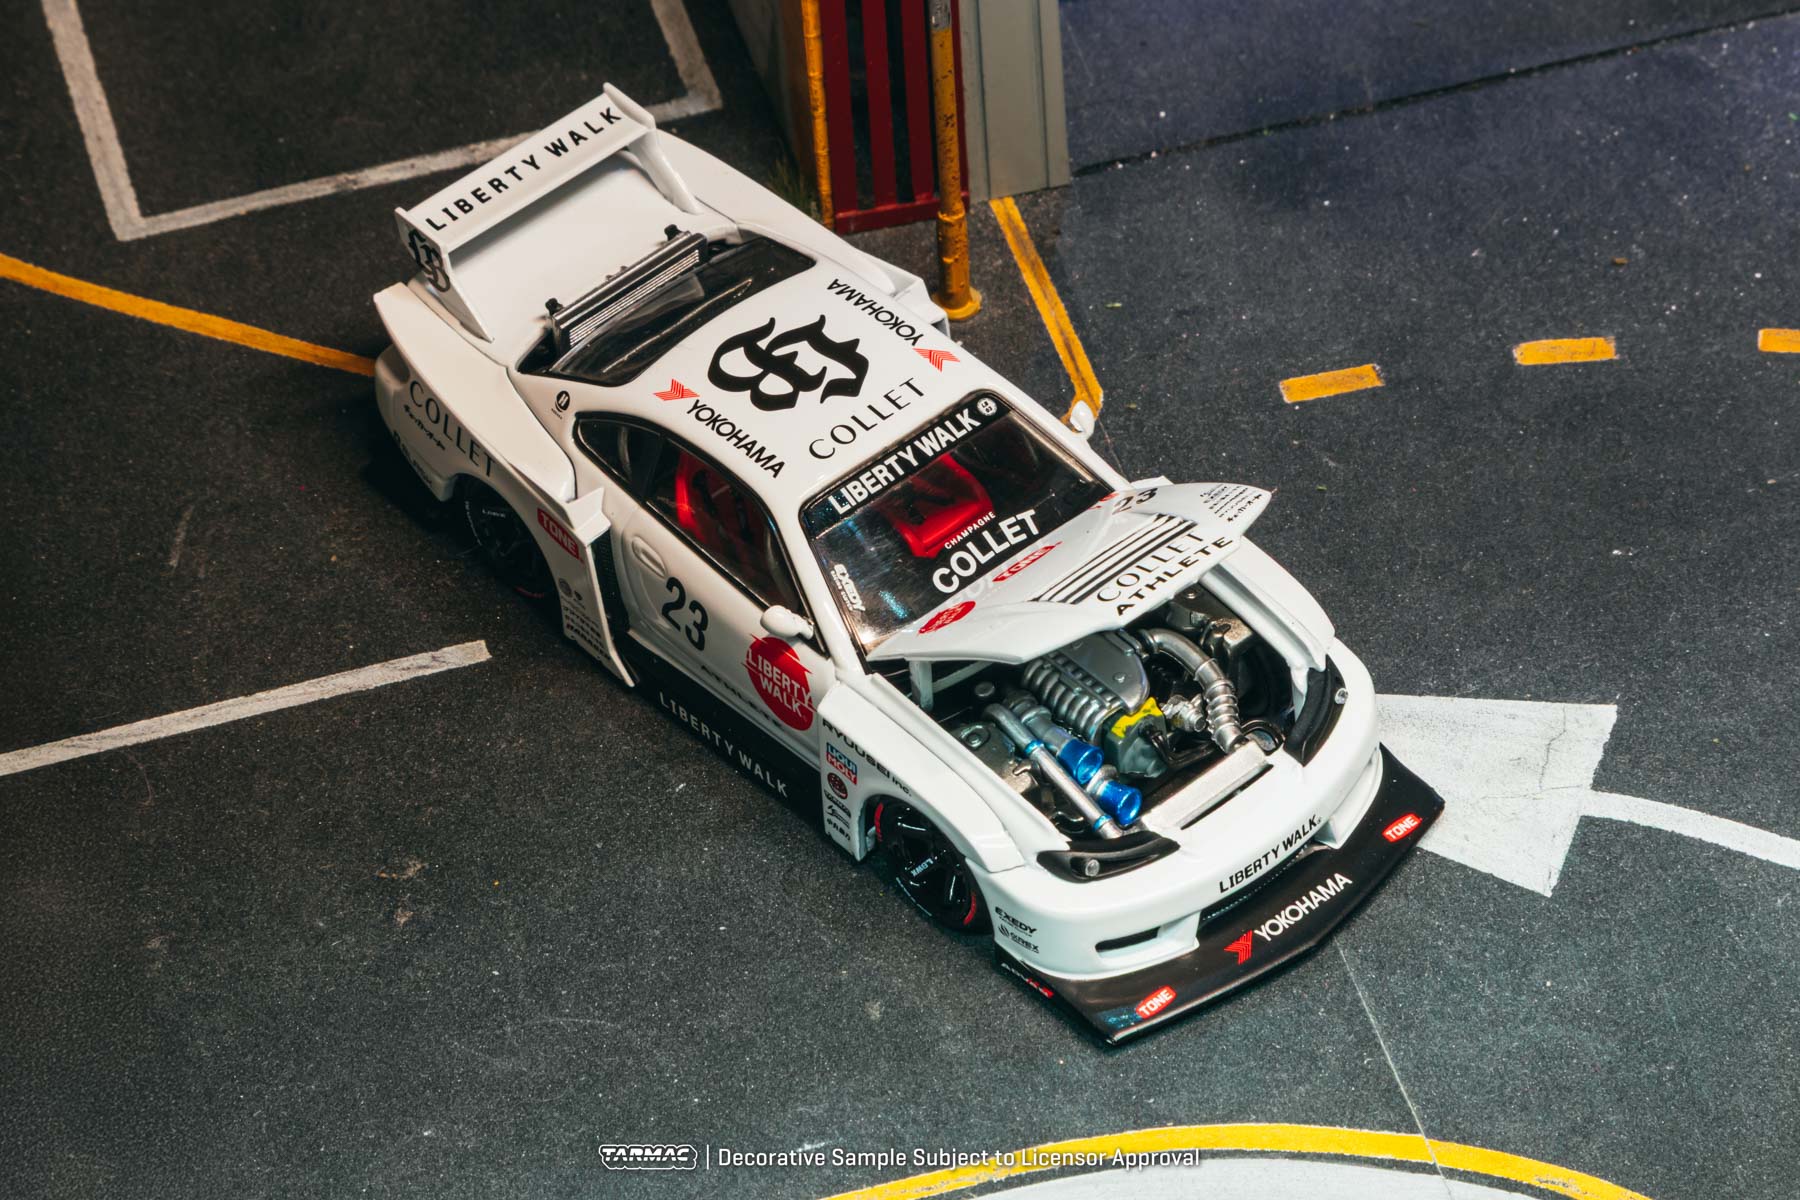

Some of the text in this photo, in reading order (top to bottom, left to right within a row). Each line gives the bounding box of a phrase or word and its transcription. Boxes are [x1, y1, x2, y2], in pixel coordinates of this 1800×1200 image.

[425, 107, 622, 232] LIBERTY WALK
[827, 278, 925, 346] YOKOHAMA
[410, 380, 496, 477] COLLET
[686, 399, 786, 478] YOKOHAMA
[809, 377, 925, 459] COLLET
[829, 408, 981, 515] LIBERTY WALK
[540, 512, 578, 558] TONE
[944, 510, 996, 550] CHAMPAGNE
[1112, 487, 1158, 515] 23
[932, 509, 1041, 594] COLLET
[1096, 530, 1204, 602] COLLET
[1115, 536, 1235, 616] ATHLETE
[662, 576, 709, 651] 23
[746, 648, 813, 707] LIBERTY
[759, 673, 802, 717] WALK
[659, 691, 734, 756] LIBERTY
[738, 750, 788, 798] WALK
[1219, 814, 1317, 894] LIBERTY WALK
[1385, 815, 1419, 839] TONE
[995, 906, 1038, 934] EXEDY
[1254, 872, 1353, 942] YOKOHAMA
[1138, 988, 1173, 1016] TONE
